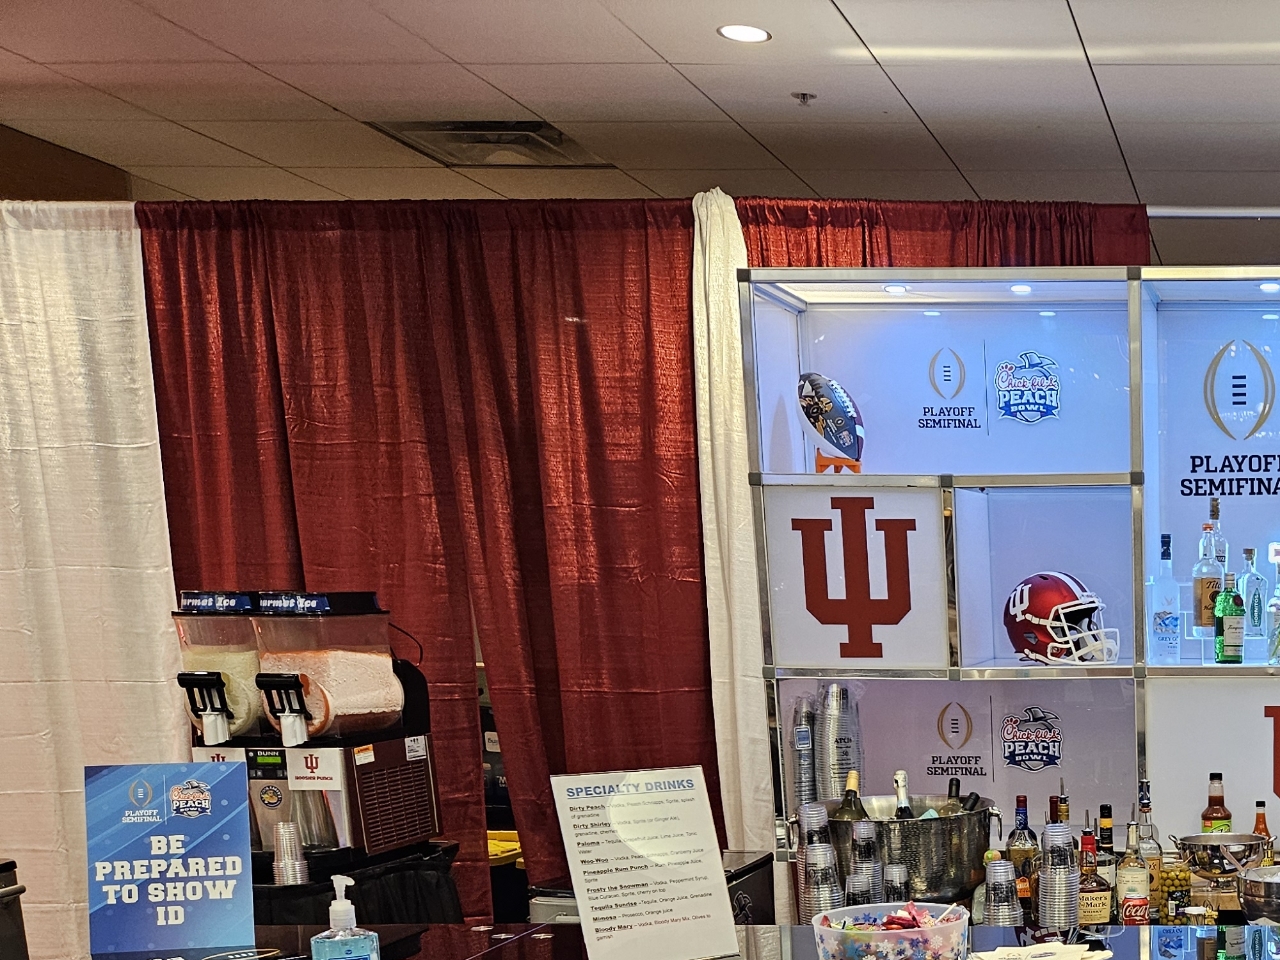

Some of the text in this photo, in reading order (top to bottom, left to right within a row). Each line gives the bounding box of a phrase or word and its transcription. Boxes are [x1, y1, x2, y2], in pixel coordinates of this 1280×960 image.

[999, 390, 1058, 407] PEACH
[922, 407, 975, 416] PLAYOFF
[1010, 404, 1047, 412] BOWL
[918, 418, 981, 429] SEMIFINAL
[216, 597, 236, 607] Ice
[1002, 723, 1061, 743] Chick-fil-A
[1003, 741, 1060, 757] PEACH
[931, 756, 981, 765] PLAYOFF
[927, 766, 987, 776] SEMIFINAL
[566, 778, 695, 797] SPECIALTY DRINKS
[172, 799, 209, 810] PEACH
[124, 809, 158, 817] PLAYOFF
[121, 815, 163, 823] SEMIFINAL
[150, 834, 185, 855] BE
[95, 855, 243, 881] PREPARED
[583, 868, 613, 876] Pineapple
[102, 879, 237, 905] TO SHOW
[1078, 894, 1108, 902] Maker's
[590, 903, 613, 911] Tequila
[156, 905, 185, 926] ID
[595, 925, 616, 933] Bloody
